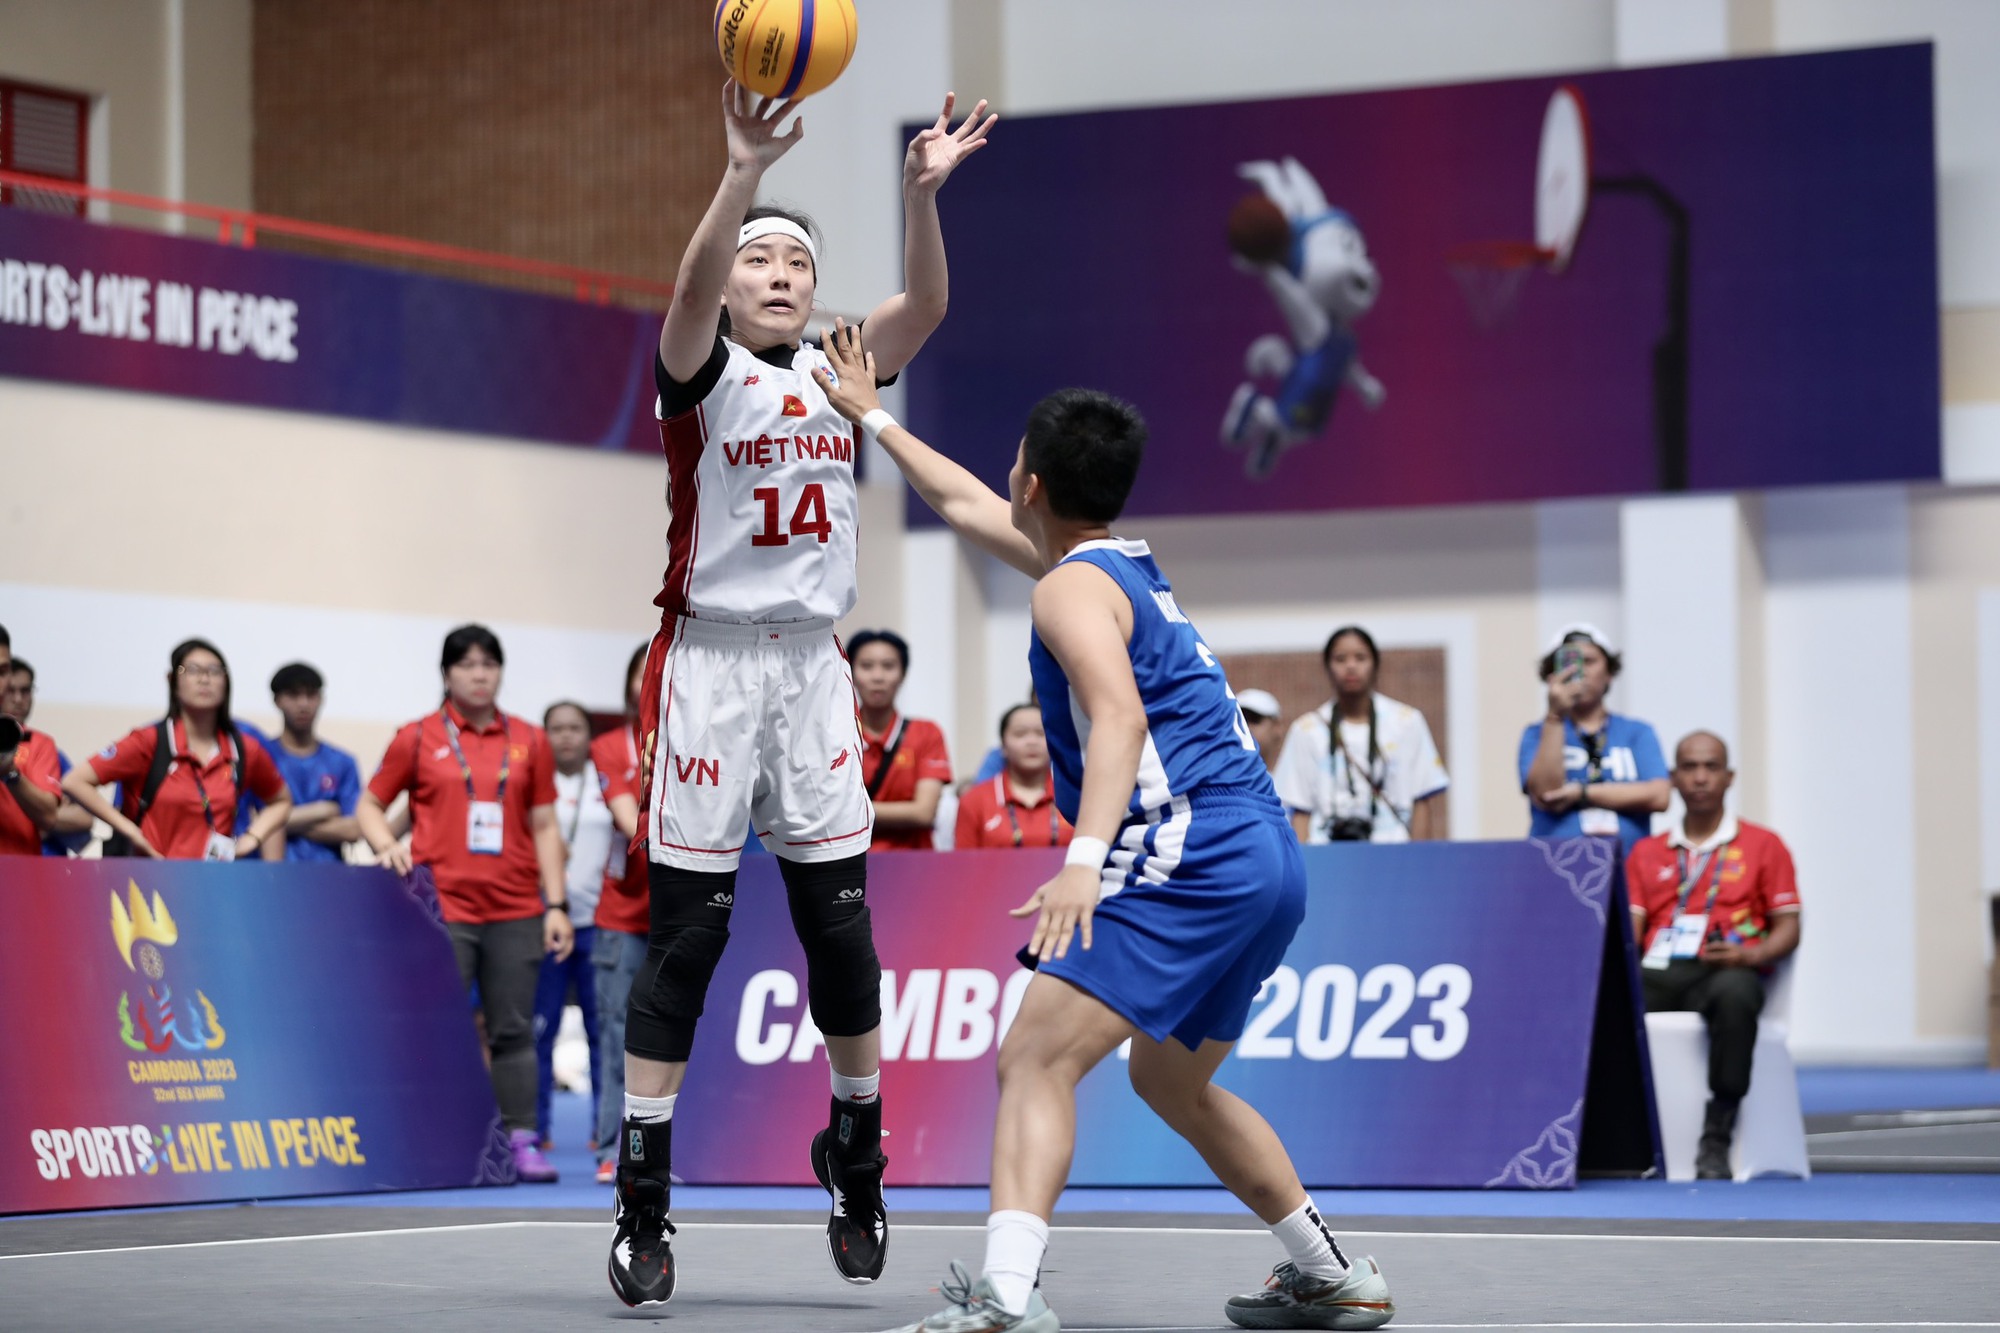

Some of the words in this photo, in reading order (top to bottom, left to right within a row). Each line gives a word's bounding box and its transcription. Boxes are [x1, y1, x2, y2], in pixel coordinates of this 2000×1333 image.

[155, 279, 194, 348] IN
[198, 286, 299, 363] PEACE
[723, 433, 789, 468] VIỆT
[794, 435, 851, 463] NAM
[752, 483, 832, 546] 14
[675, 755, 719, 786] VN
[1236, 963, 1472, 1061] 2023
[128, 1059, 203, 1084] CAMBODIA
[202, 1058, 237, 1082] 2023
[230, 1120, 270, 1169] IN
[269, 1116, 366, 1168] PEACE
